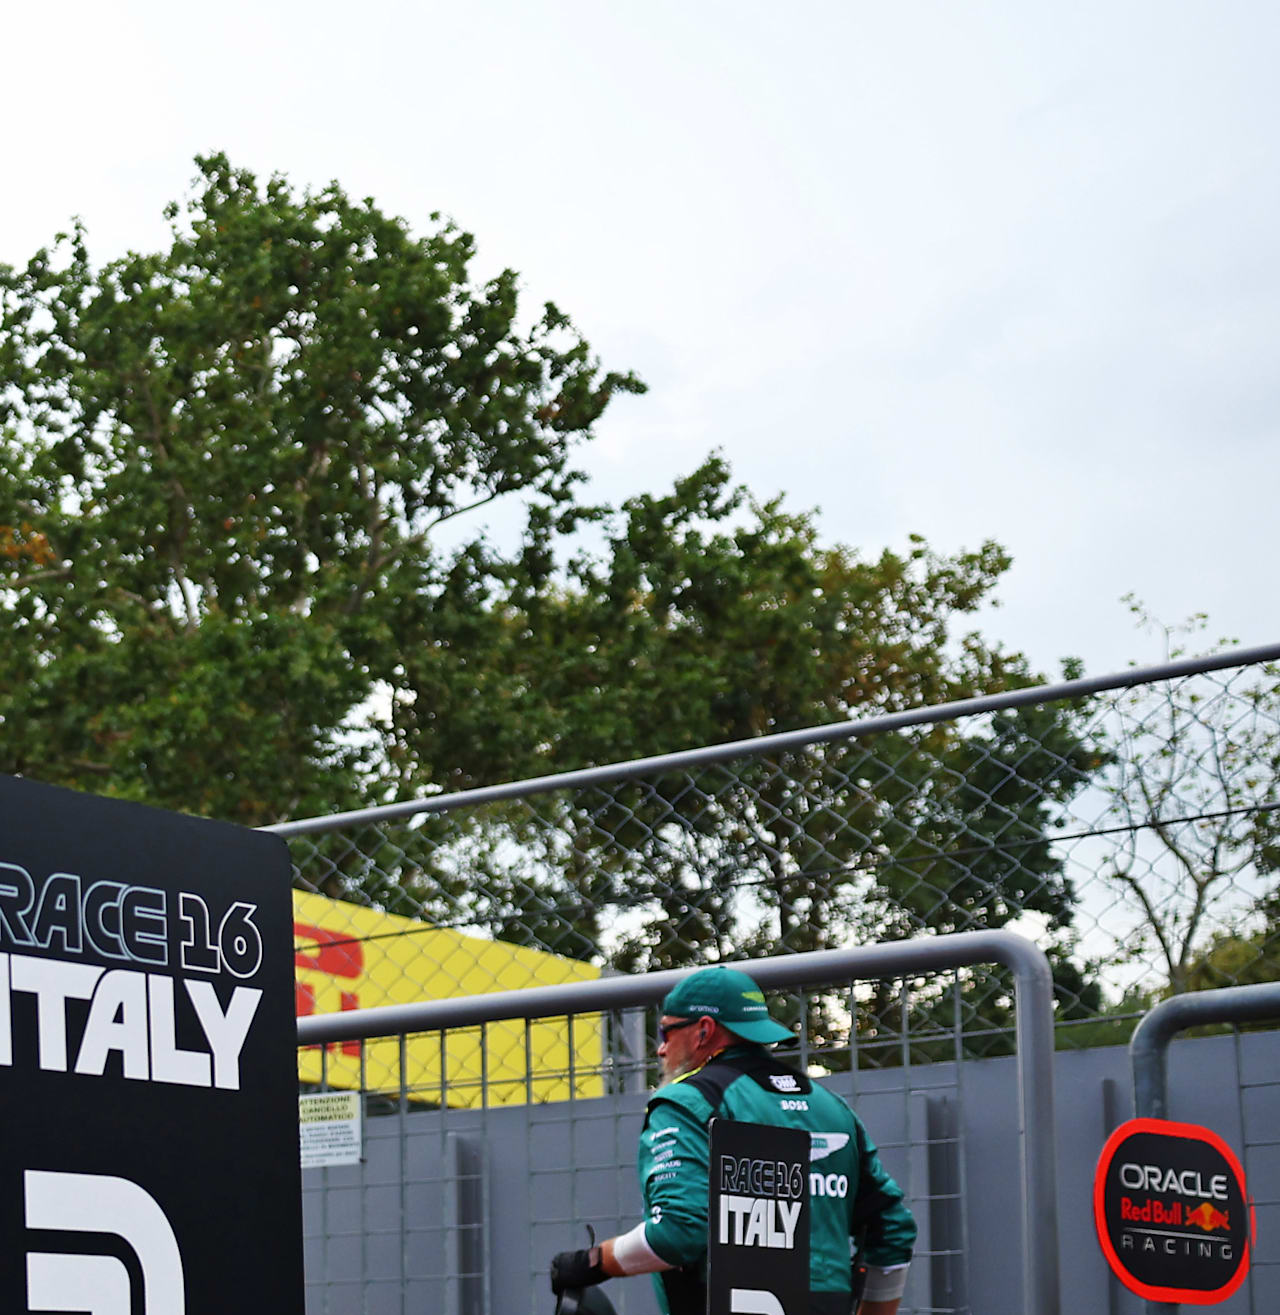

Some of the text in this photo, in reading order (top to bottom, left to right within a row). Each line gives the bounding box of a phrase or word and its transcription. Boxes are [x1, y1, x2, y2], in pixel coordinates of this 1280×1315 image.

[179, 892, 263, 978] 16
[781, 1100, 808, 1111] BOSS
[720, 1155, 803, 1199] RACE 16
[1120, 1163, 1228, 1200] ORACLE
[719, 1195, 803, 1250] ITALY
[1122, 1234, 1233, 1260] RACING
